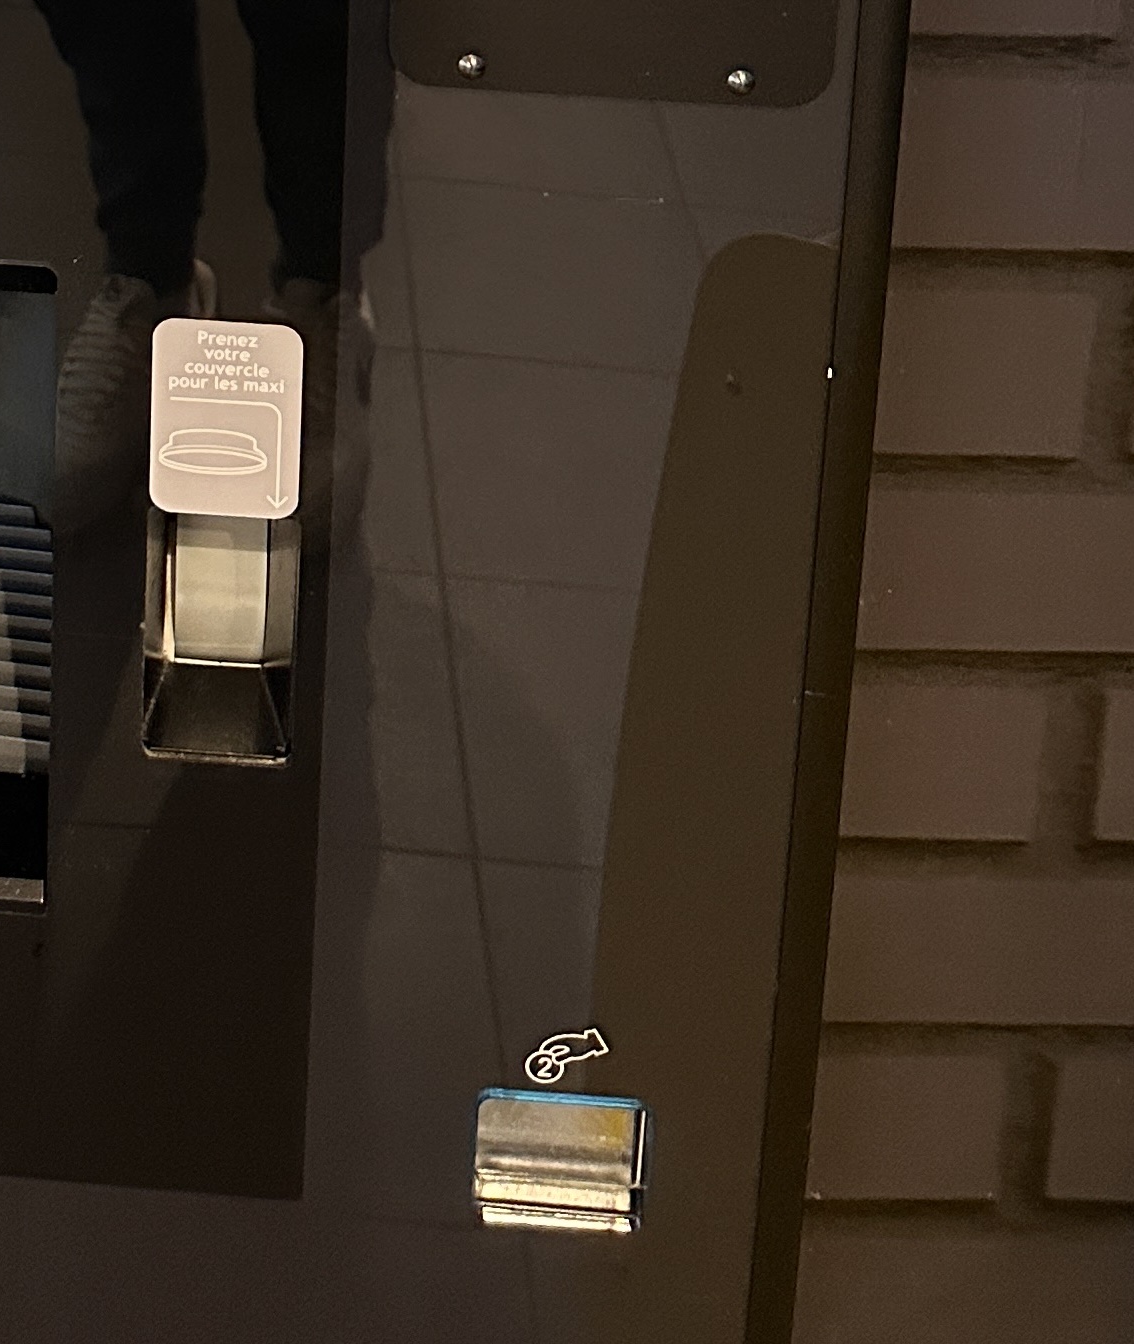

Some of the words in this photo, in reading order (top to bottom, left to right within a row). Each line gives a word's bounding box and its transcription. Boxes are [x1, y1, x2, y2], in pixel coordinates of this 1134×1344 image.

[197, 330, 259, 348] Prenez
[204, 348, 251, 362] votre
[184, 362, 270, 378] couvercle
[169, 375, 208, 391] pour
[215, 376, 238, 391] les
[243, 378, 285, 394] maxi
